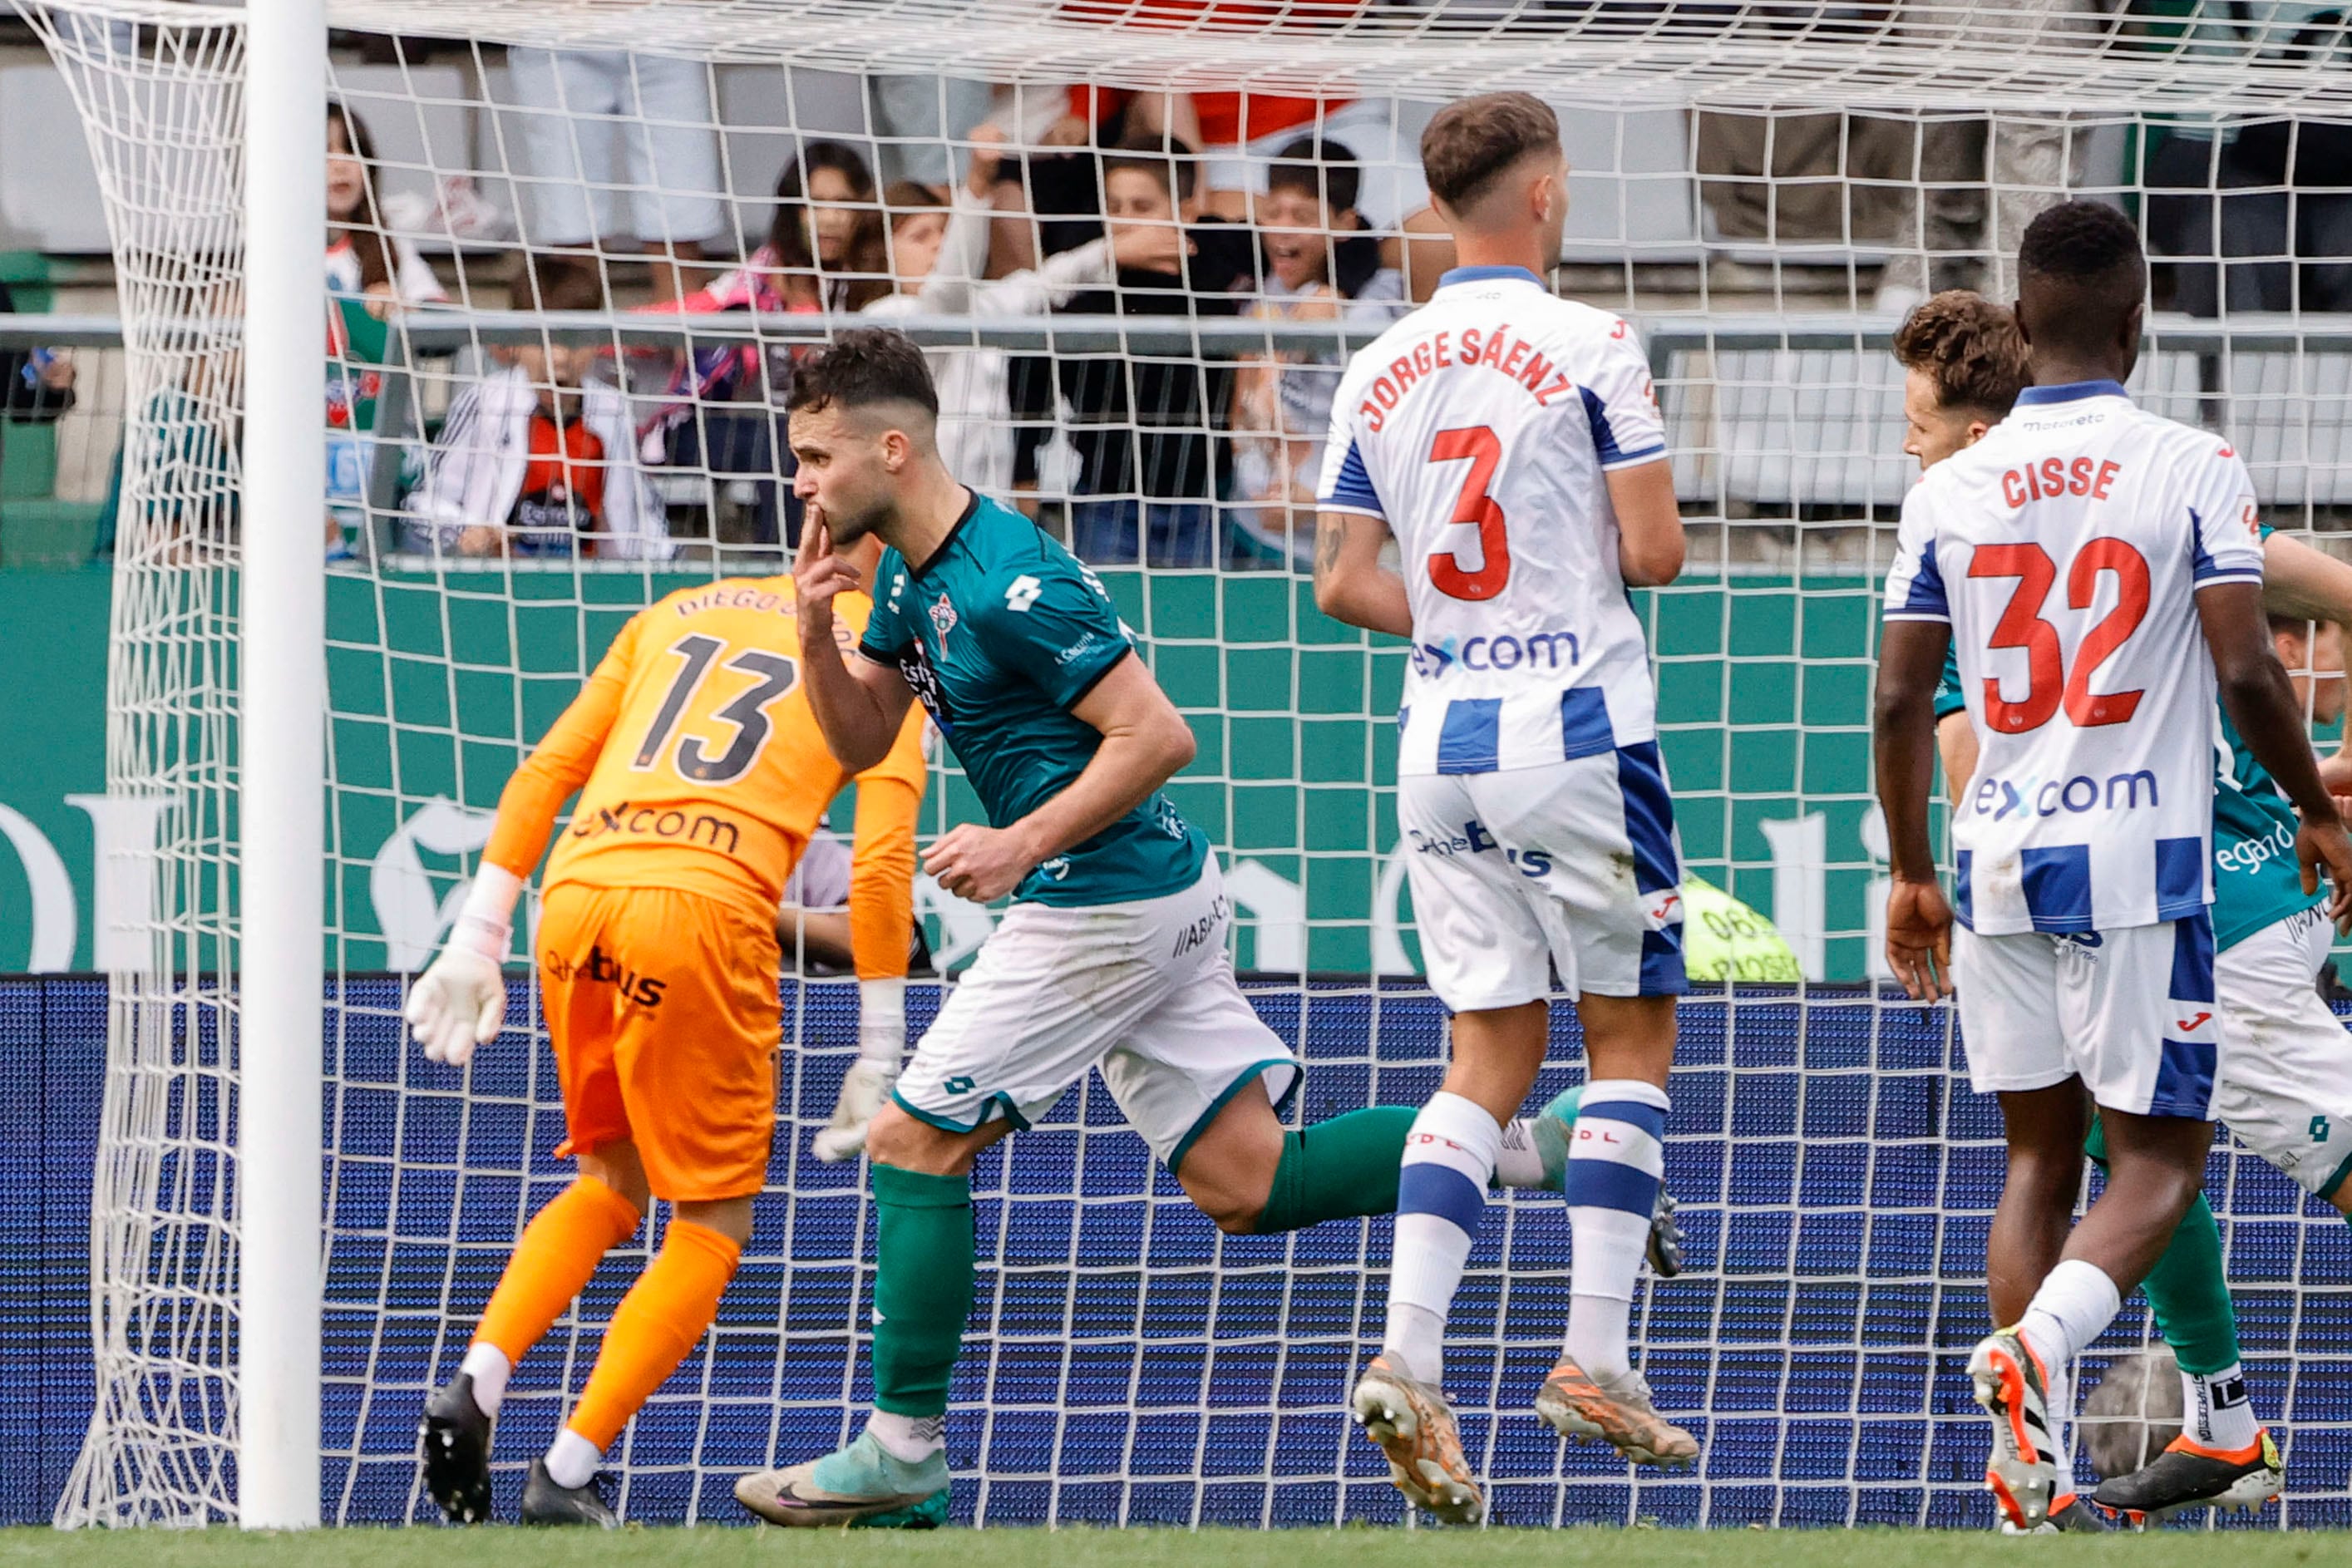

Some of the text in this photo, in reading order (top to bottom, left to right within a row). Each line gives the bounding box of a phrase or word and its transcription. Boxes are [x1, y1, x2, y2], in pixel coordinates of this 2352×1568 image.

[1359, 323, 1572, 432] JORGE SÁENZ
[1428, 425, 1511, 601] 3
[2001, 456, 2122, 509] CISSE
[676, 588, 779, 618] DIEGO
[1966, 536, 2152, 734] 32
[1413, 630, 1580, 679] excom
[629, 632, 801, 786] 13
[1975, 768, 2159, 822] excom
